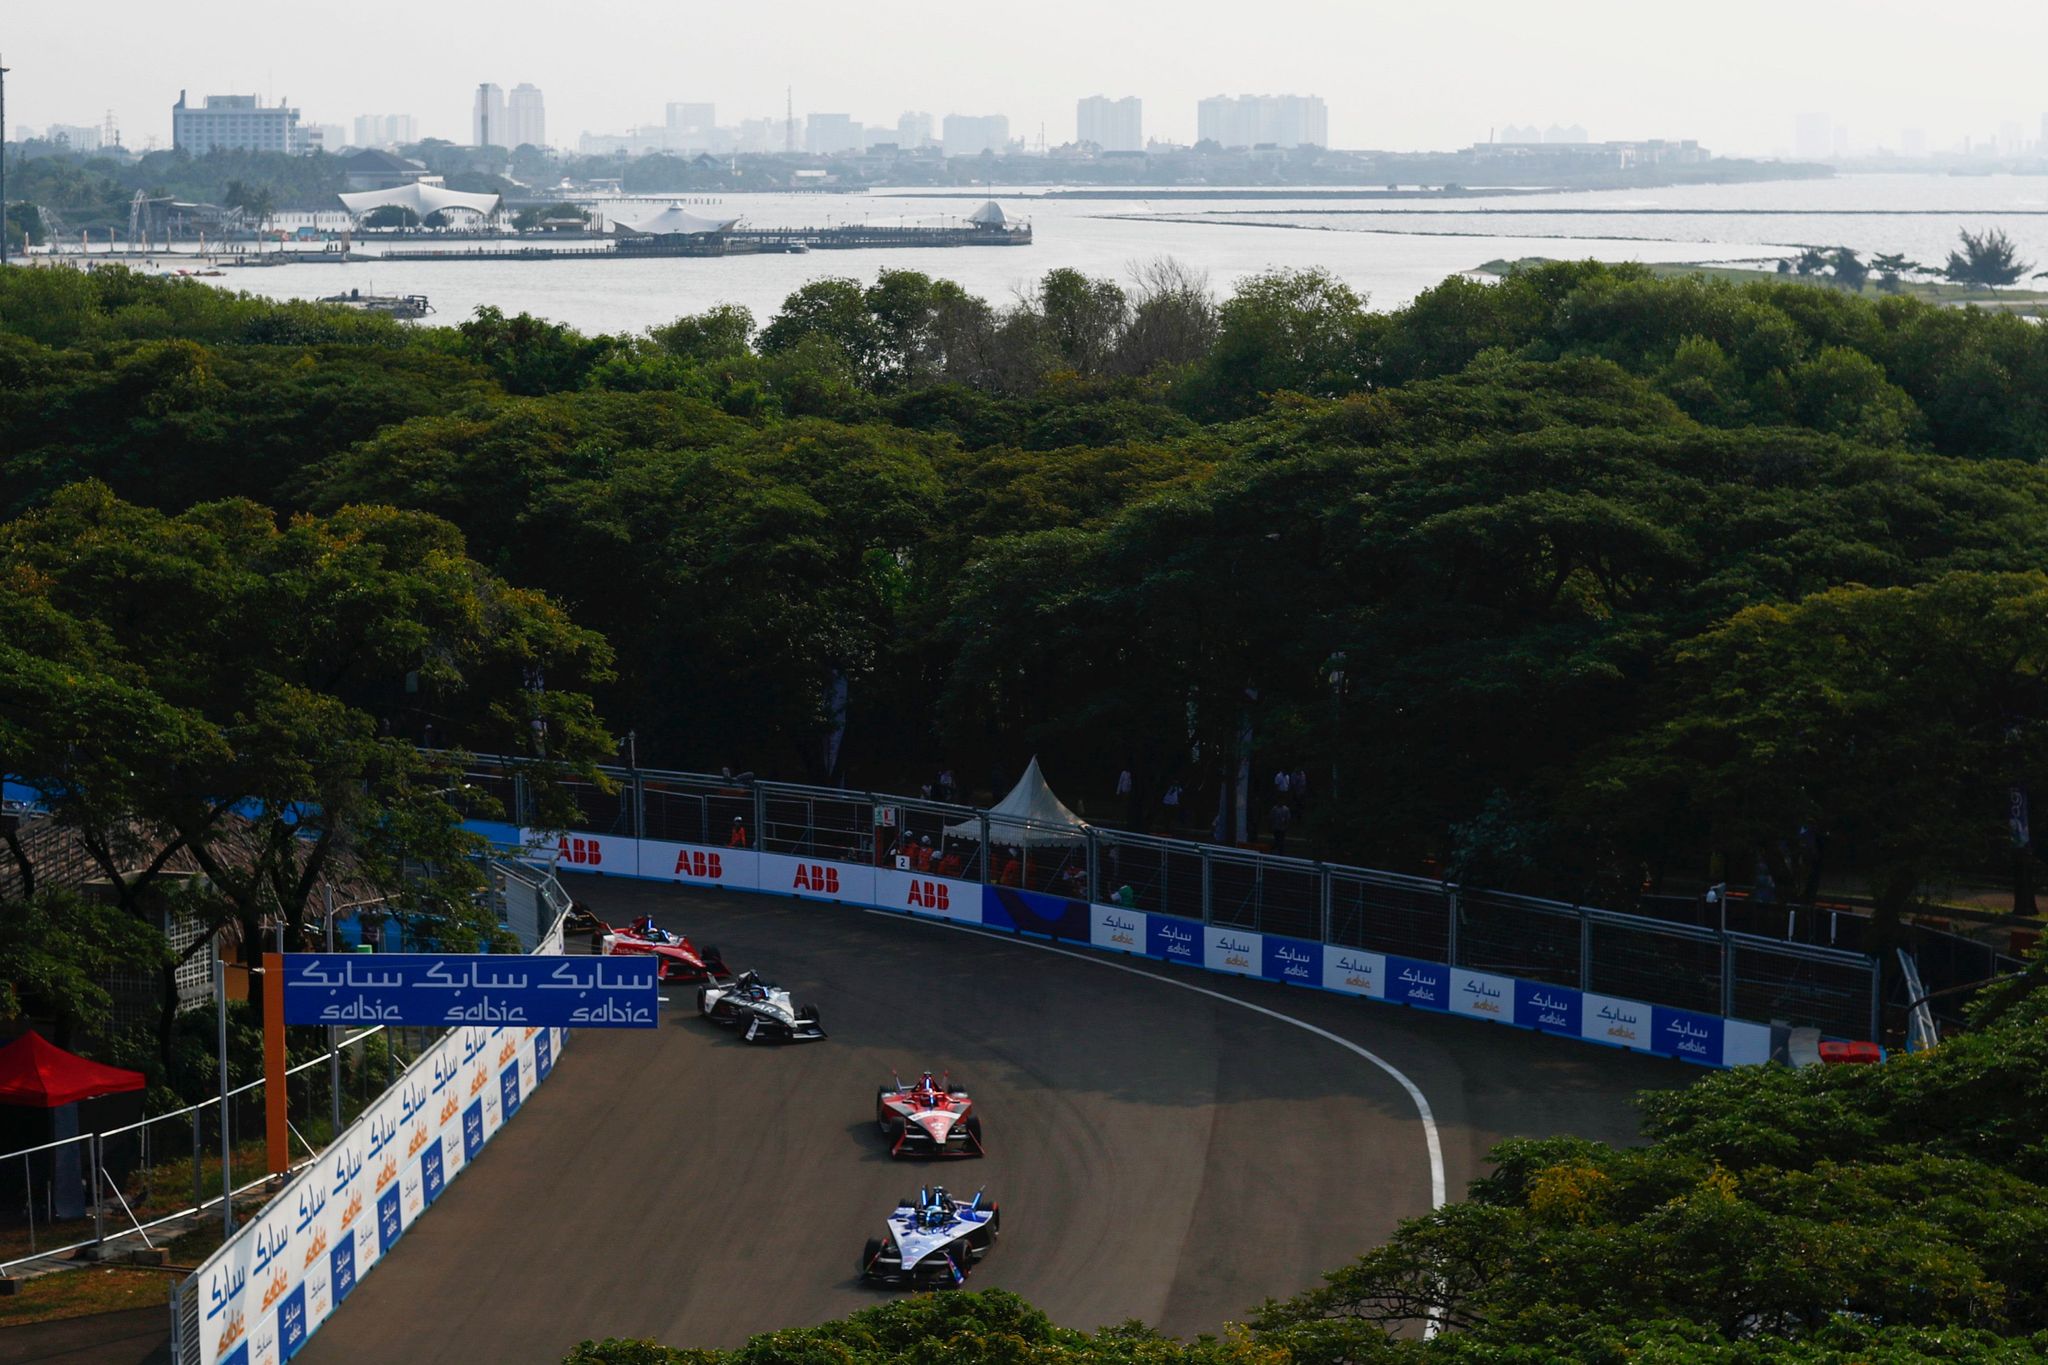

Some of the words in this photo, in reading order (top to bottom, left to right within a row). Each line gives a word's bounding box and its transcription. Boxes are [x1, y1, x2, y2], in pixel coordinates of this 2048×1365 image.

[557, 837, 602, 865] ABB
[675, 849, 722, 878] ABB
[900, 857, 905, 867] 2
[793, 863, 839, 893] ABB
[907, 879, 950, 910] ABB
[1167, 944, 1191, 957] sabic
[1284, 965, 1309, 978] sabic
[1408, 986, 1435, 1001] sabic
[319, 994, 403, 1020] sabic
[443, 996, 528, 1021] sabic
[569, 997, 653, 1023] sabic
[1538, 1012, 1567, 1027] sabic
[1677, 1040, 1707, 1055] sabic
